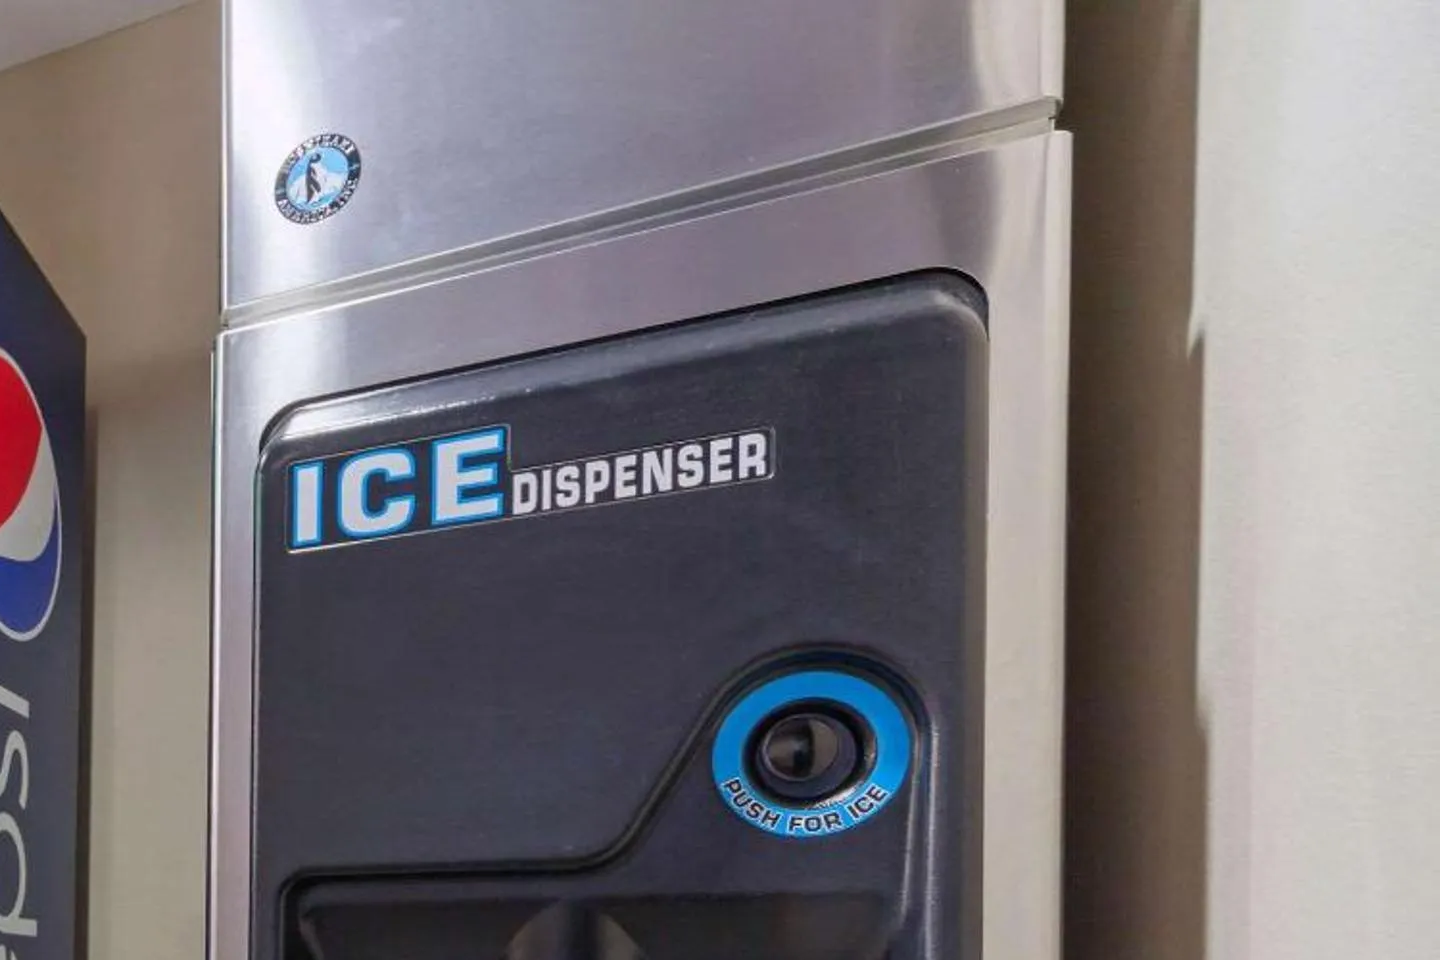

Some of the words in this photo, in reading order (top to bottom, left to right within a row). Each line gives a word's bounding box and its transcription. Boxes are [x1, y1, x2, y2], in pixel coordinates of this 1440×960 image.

[290, 426, 507, 548] ICE
[512, 431, 769, 516] DISPENSER
[724, 777, 782, 829] PUSH
[788, 812, 843, 834] FOR
[847, 783, 889, 819] ICE
